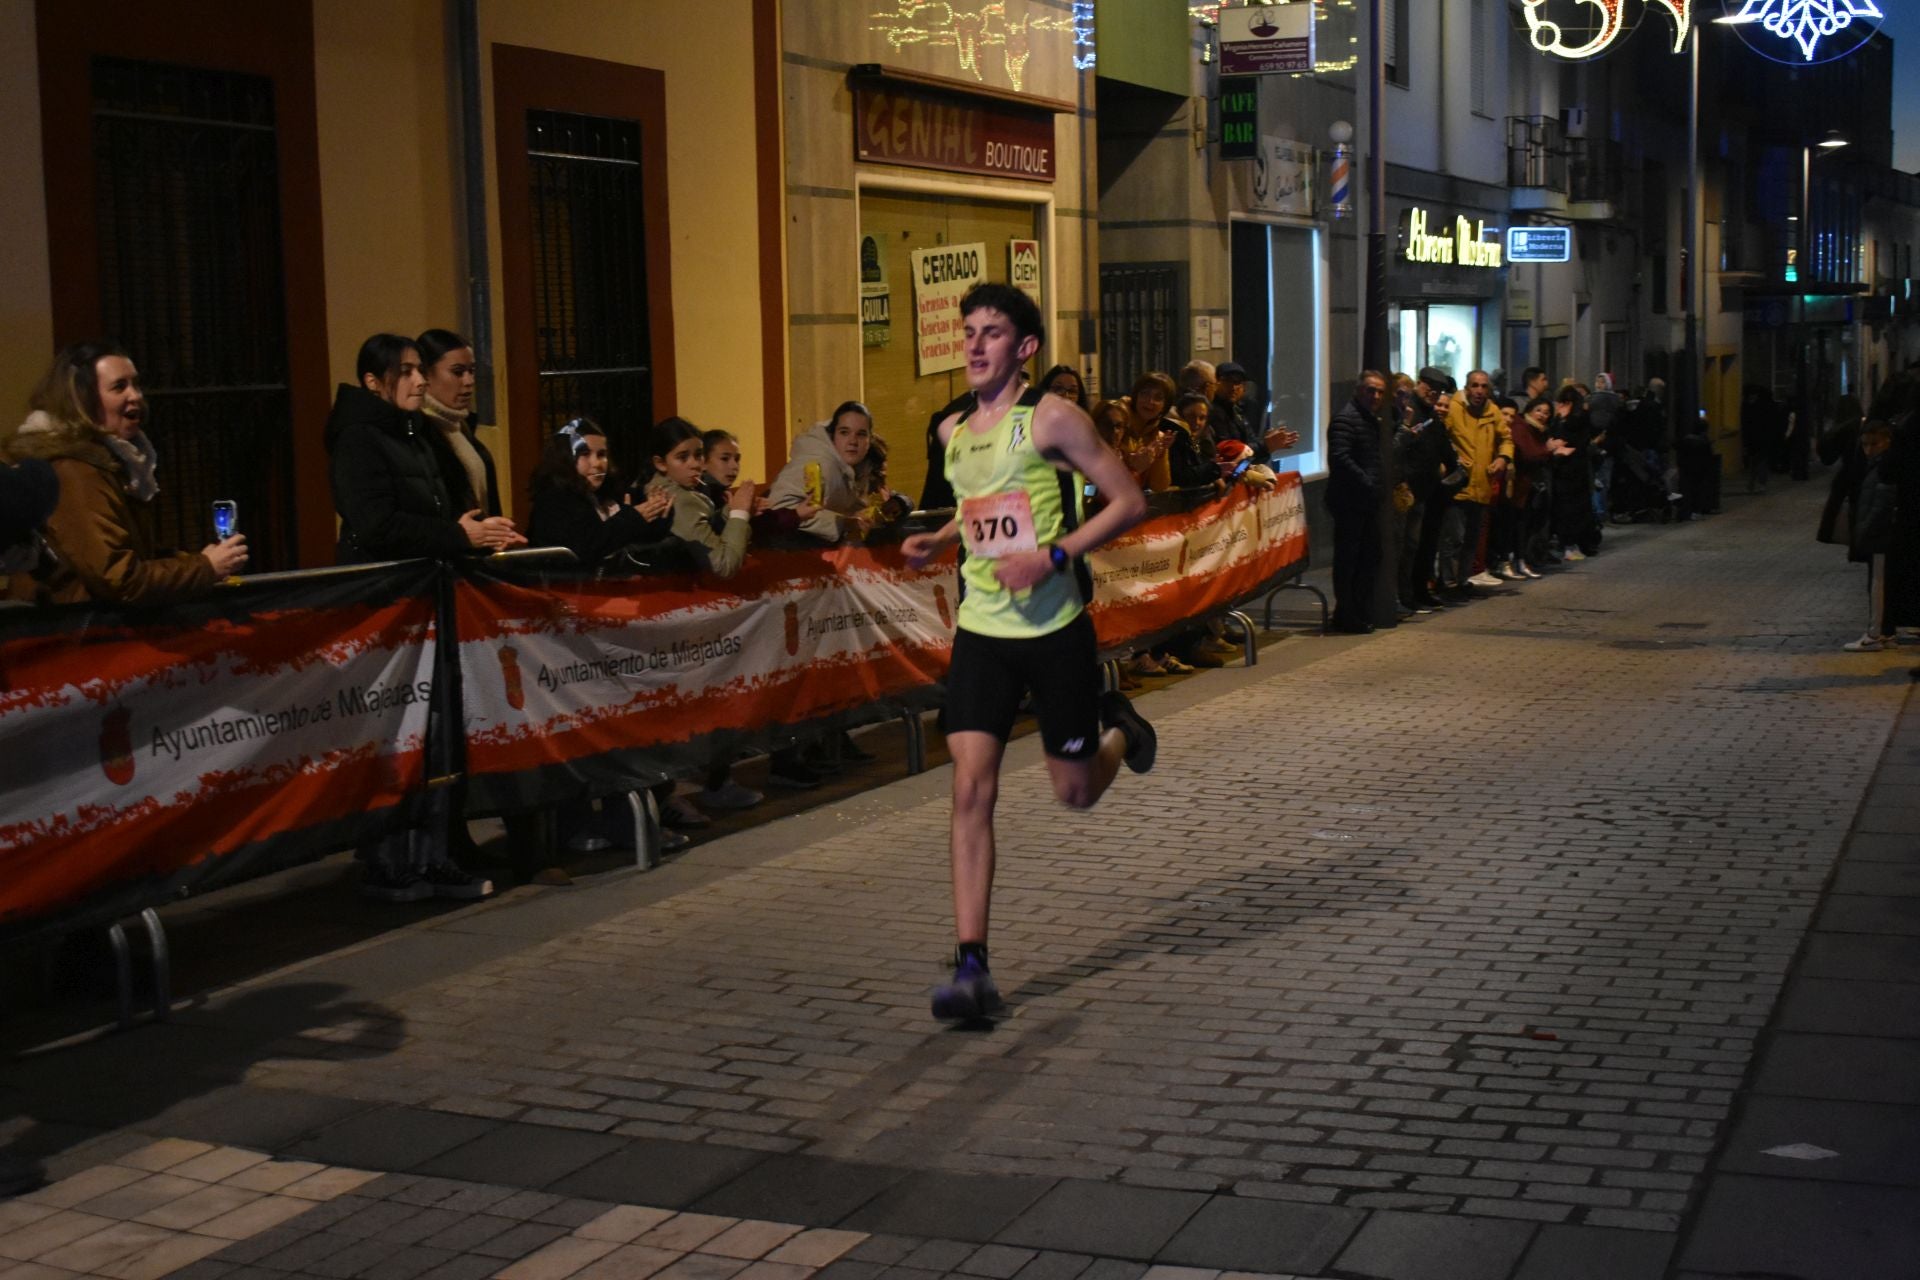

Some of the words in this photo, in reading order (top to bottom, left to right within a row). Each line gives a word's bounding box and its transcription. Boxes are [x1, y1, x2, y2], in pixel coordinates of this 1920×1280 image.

[866, 93, 977, 165] GENIAL
[1224, 122, 1253, 143] BAR
[985, 141, 1049, 173] BOUTIQUE
[922, 250, 978, 285] CERRADO
[1015, 264, 1038, 281] CIEM
[862, 297, 889, 323] QUILA
[972, 516, 1018, 542] 370
[537, 651, 645, 693] Ayuntamiento
[649, 648, 669, 669] de
[671, 634, 742, 667] Miajadas
[151, 706, 309, 761] Ayuntamiento
[310, 699, 332, 723] de
